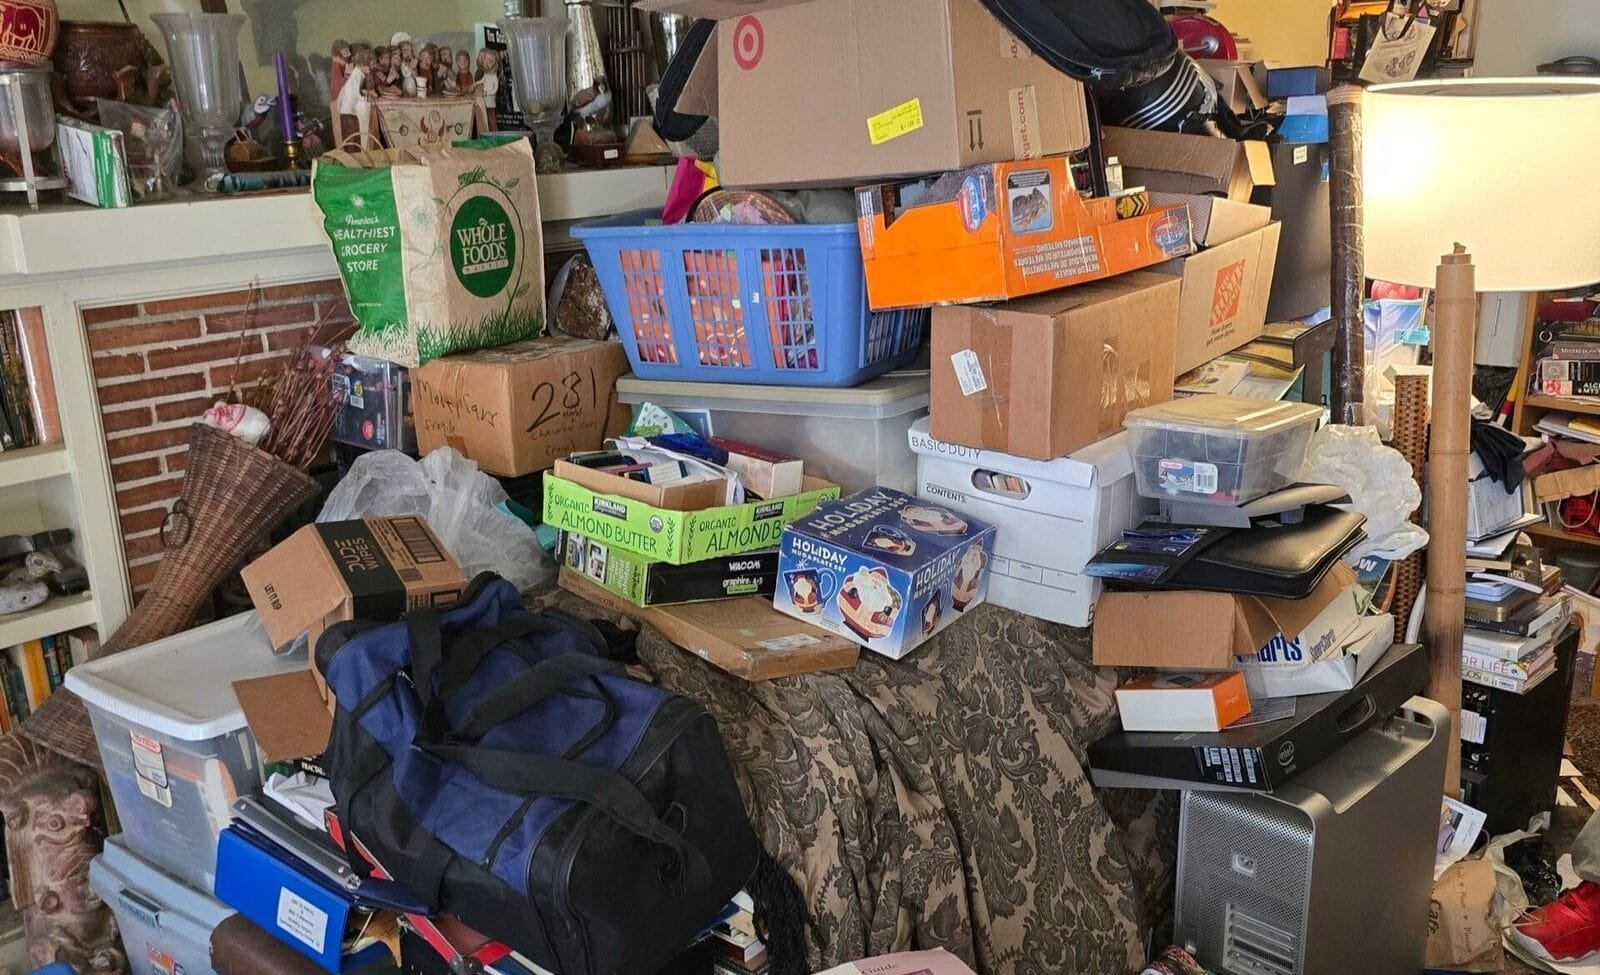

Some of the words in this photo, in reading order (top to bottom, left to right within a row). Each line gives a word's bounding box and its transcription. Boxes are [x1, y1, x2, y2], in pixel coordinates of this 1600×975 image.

[334, 226, 395, 239] HEALTHIEST
[457, 220, 507, 246] WHOLE
[462, 243, 507, 265] FOODS
[347, 259, 378, 273] STORE
[527, 367, 597, 433] 281
[911, 436, 946, 454] BASIC
[949, 442, 982, 460] DUTY
[554, 494, 590, 514] ORGANIC
[594, 496, 626, 515] KIRKLAND
[755, 502, 784, 517] KIRKLAND
[808, 490, 890, 532] HOLIDAY
[560, 512, 612, 541] ALMOND
[614, 527, 657, 552] BUTTER
[699, 517, 736, 531] ORGANIC
[706, 524, 766, 553] ALMOND
[352, 537, 379, 570] WIPES
[792, 537, 848, 566] HOLIDAY
[728, 559, 761, 572] WACOM
[916, 549, 961, 590] HOLIDAY
[1482, 659, 1509, 674] LIFE
